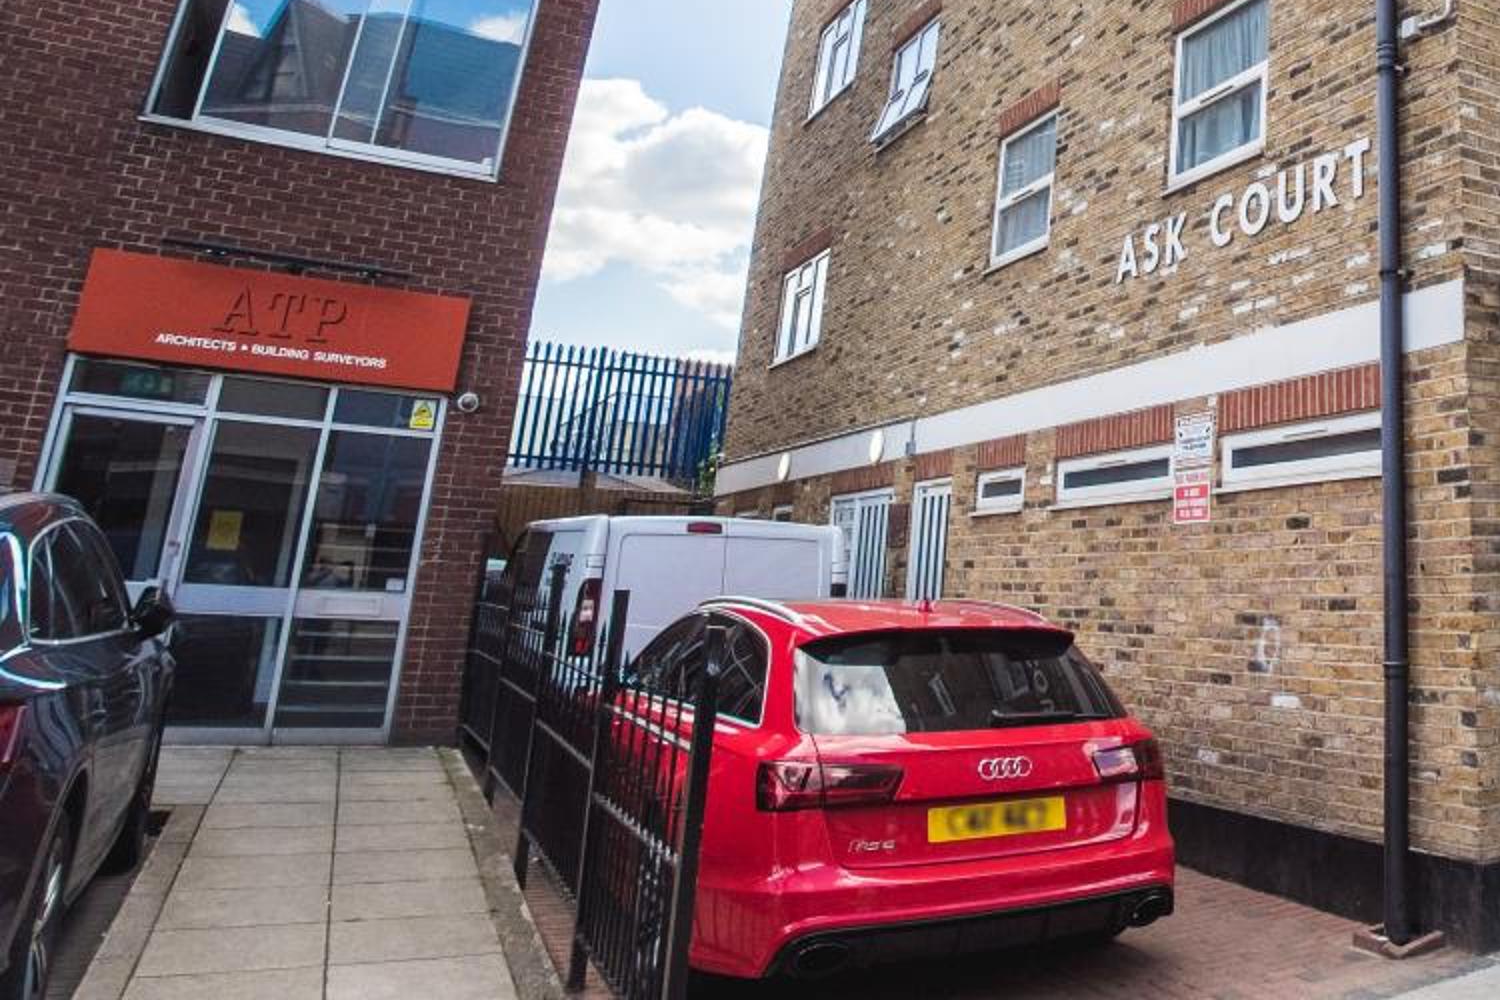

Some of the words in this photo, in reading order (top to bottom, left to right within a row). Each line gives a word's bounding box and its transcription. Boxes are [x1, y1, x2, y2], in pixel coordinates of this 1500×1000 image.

[1116, 211, 1188, 284] ASK
[1209, 137, 1372, 249] COURT
[211, 282, 349, 344] ATP
[155, 333, 237, 351] ARCHITECTS
[251, 343, 309, 360] BUILDING
[312, 351, 387, 368] SURVEYORS
